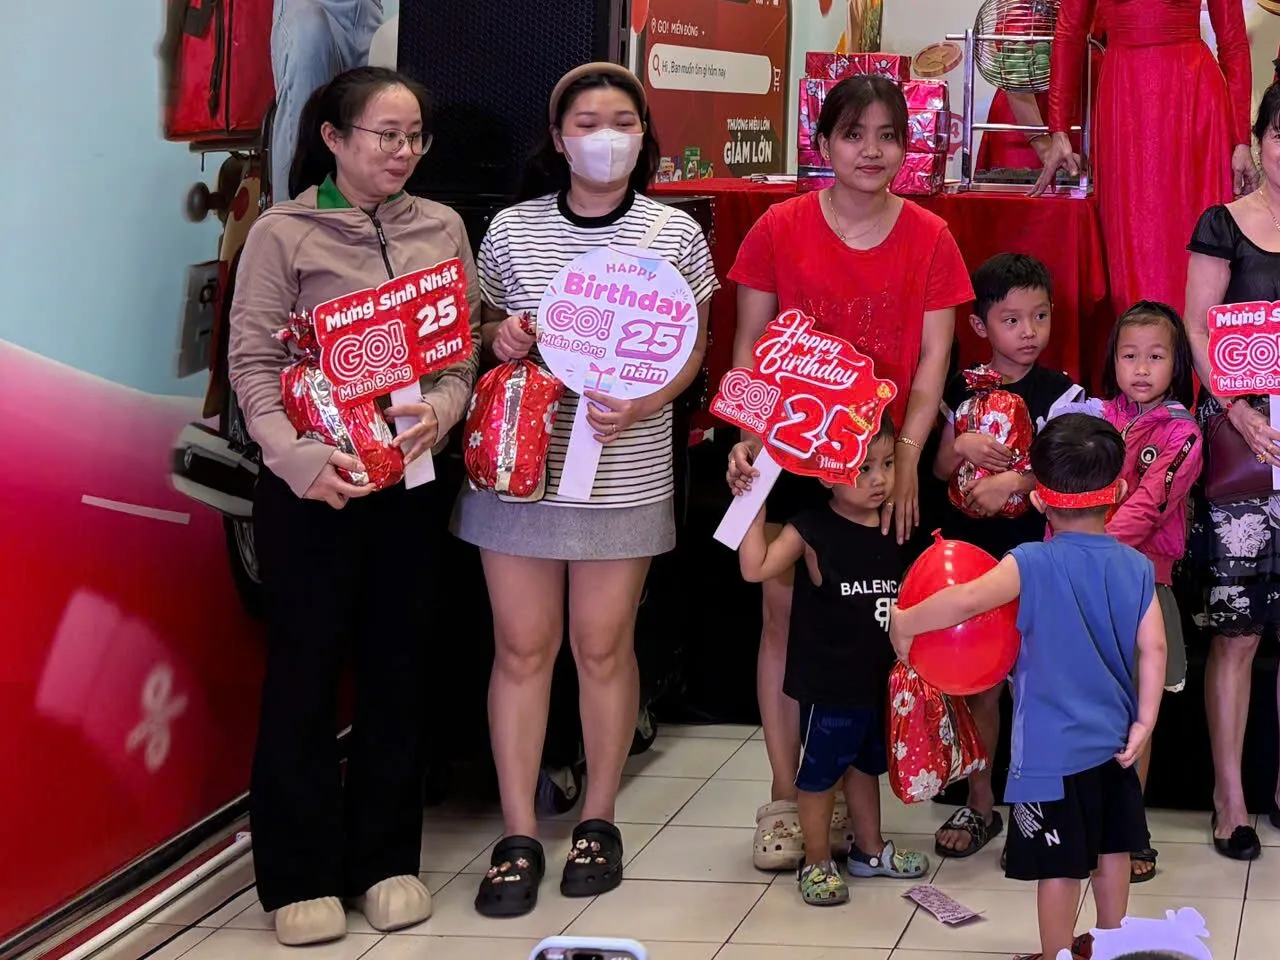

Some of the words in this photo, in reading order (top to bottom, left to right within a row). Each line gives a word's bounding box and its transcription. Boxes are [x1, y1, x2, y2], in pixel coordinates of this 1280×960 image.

[657, 19, 669, 34] GO!
[723, 132, 750, 165] GIẢM
[752, 135, 772, 163] LỚN
[377, 283, 417, 311] Sinh
[419, 265, 459, 294] Nhật
[606, 262, 657, 281] HAPPY
[416, 295, 458, 338] 25
[564, 271, 692, 323] Birthday
[546, 299, 616, 340] GO!
[771, 309, 866, 367] Happy
[330, 319, 408, 381] GO!
[425, 337, 463, 364] năm
[571, 339, 607, 359] Đông
[615, 319, 687, 363] 25
[374, 365, 413, 388] Đông
[619, 363, 669, 385] năm
[755, 337, 859, 390] Birthday
[722, 370, 781, 418] GO!
[739, 412, 767, 433] Đông
[768, 394, 870, 469] 25
